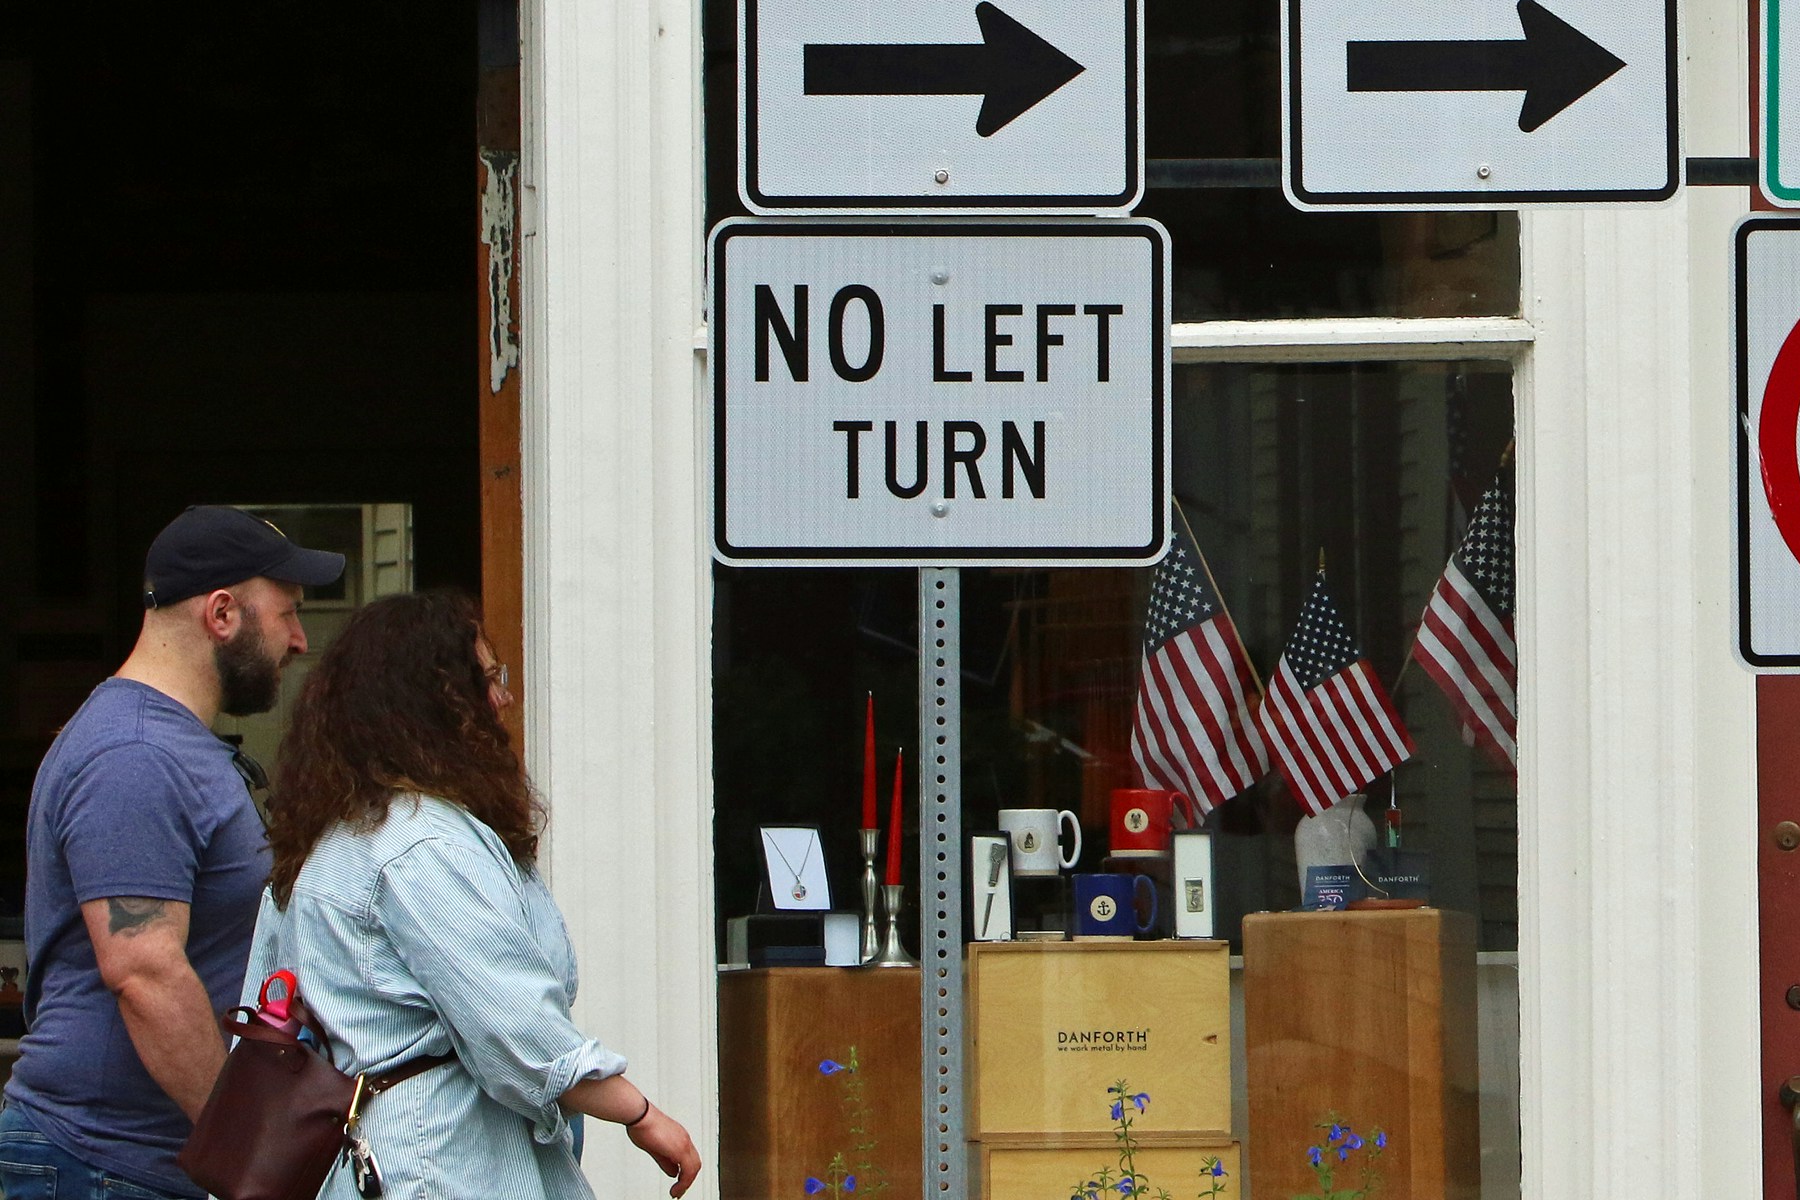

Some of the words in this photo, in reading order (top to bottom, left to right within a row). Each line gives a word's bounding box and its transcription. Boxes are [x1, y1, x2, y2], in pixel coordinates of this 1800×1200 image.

[754, 283, 885, 383] NO
[932, 303, 1124, 383] LEFT
[832, 420, 1046, 500] TURN
[1070, 1044, 1088, 1052] work
[1091, 1044, 1113, 1052] metal
[1116, 1044, 1126, 1052] by
